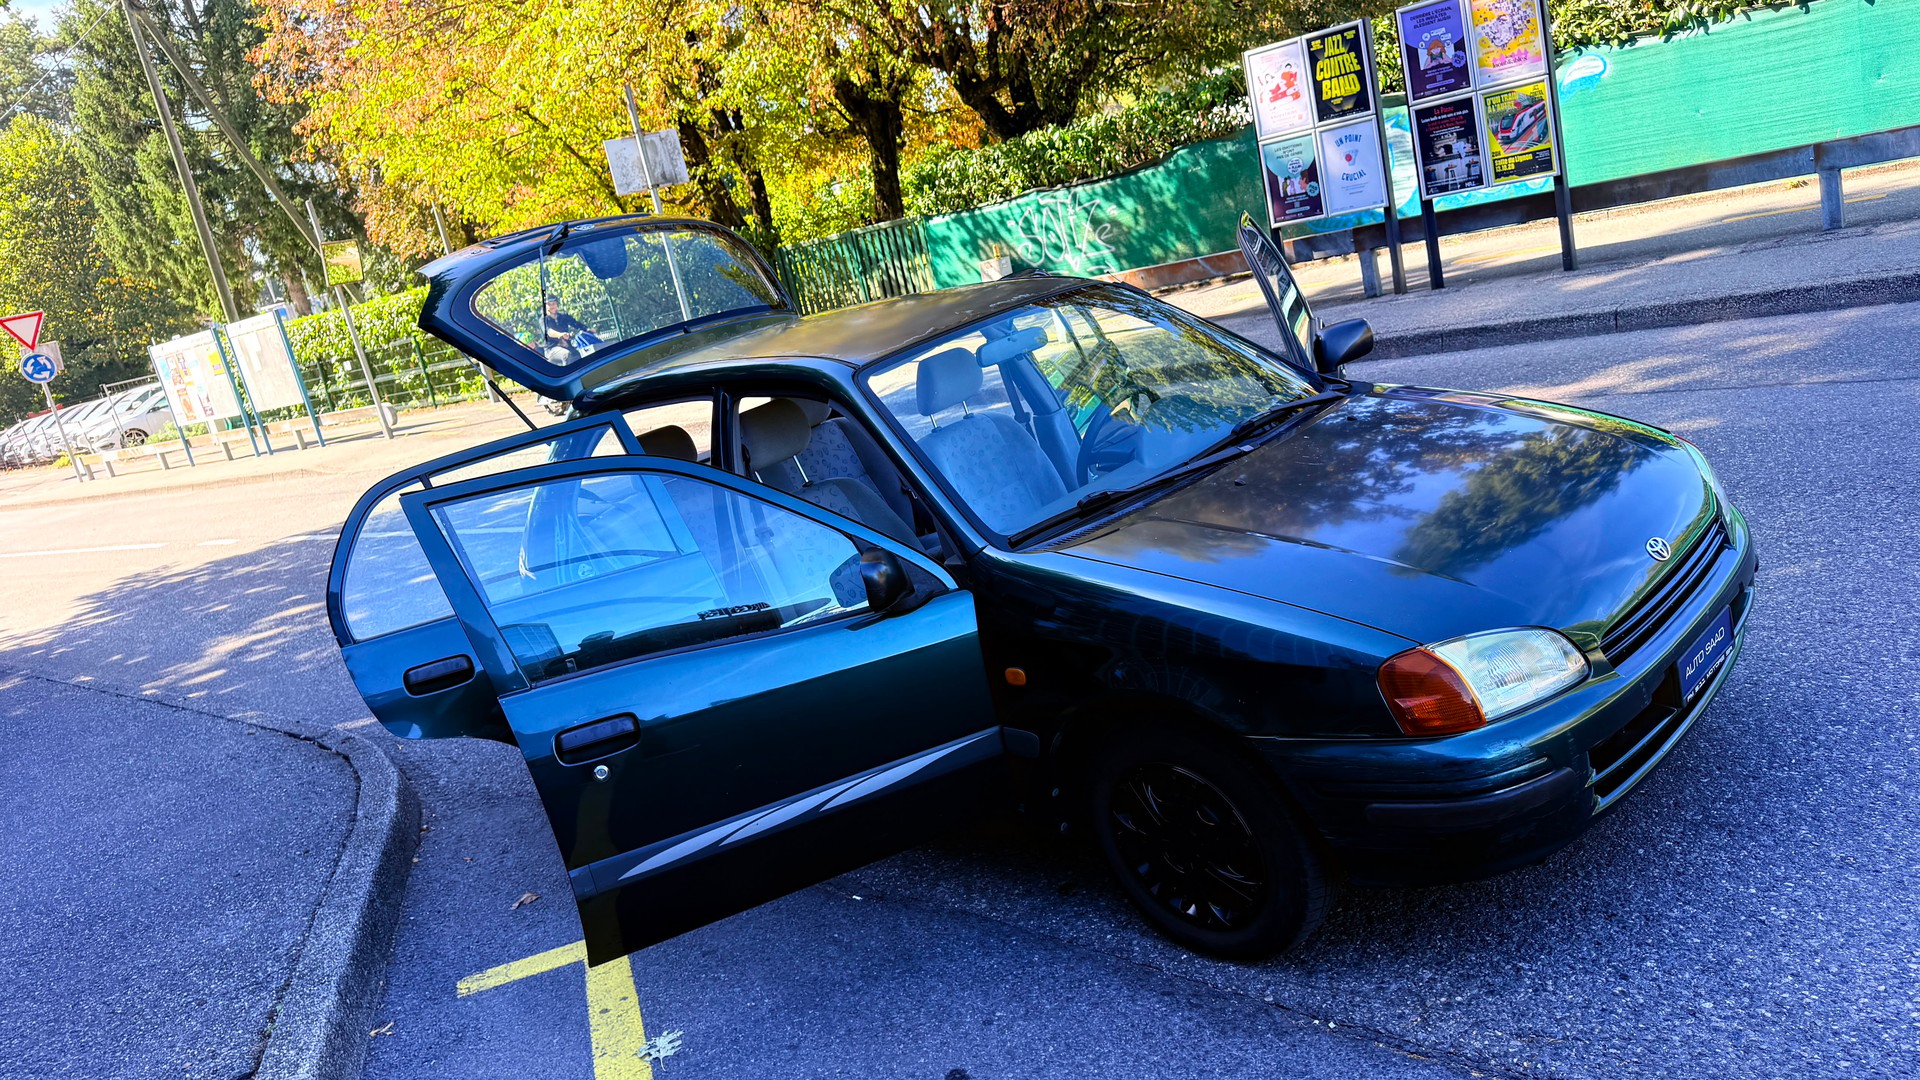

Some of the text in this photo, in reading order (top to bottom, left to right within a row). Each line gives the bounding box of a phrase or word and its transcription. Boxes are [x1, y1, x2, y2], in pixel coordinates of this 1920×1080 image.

[1324, 34, 1347, 57] JAZZ
[1316, 52, 1361, 81] CONTRE
[1322, 73, 1362, 101] BAND
[1335, 134, 1362, 147] UN POINT
[1341, 169, 1367, 181] CRUCIAL
[1685, 650, 1705, 680] AUTO
[1705, 626, 1725, 655] SAAD
